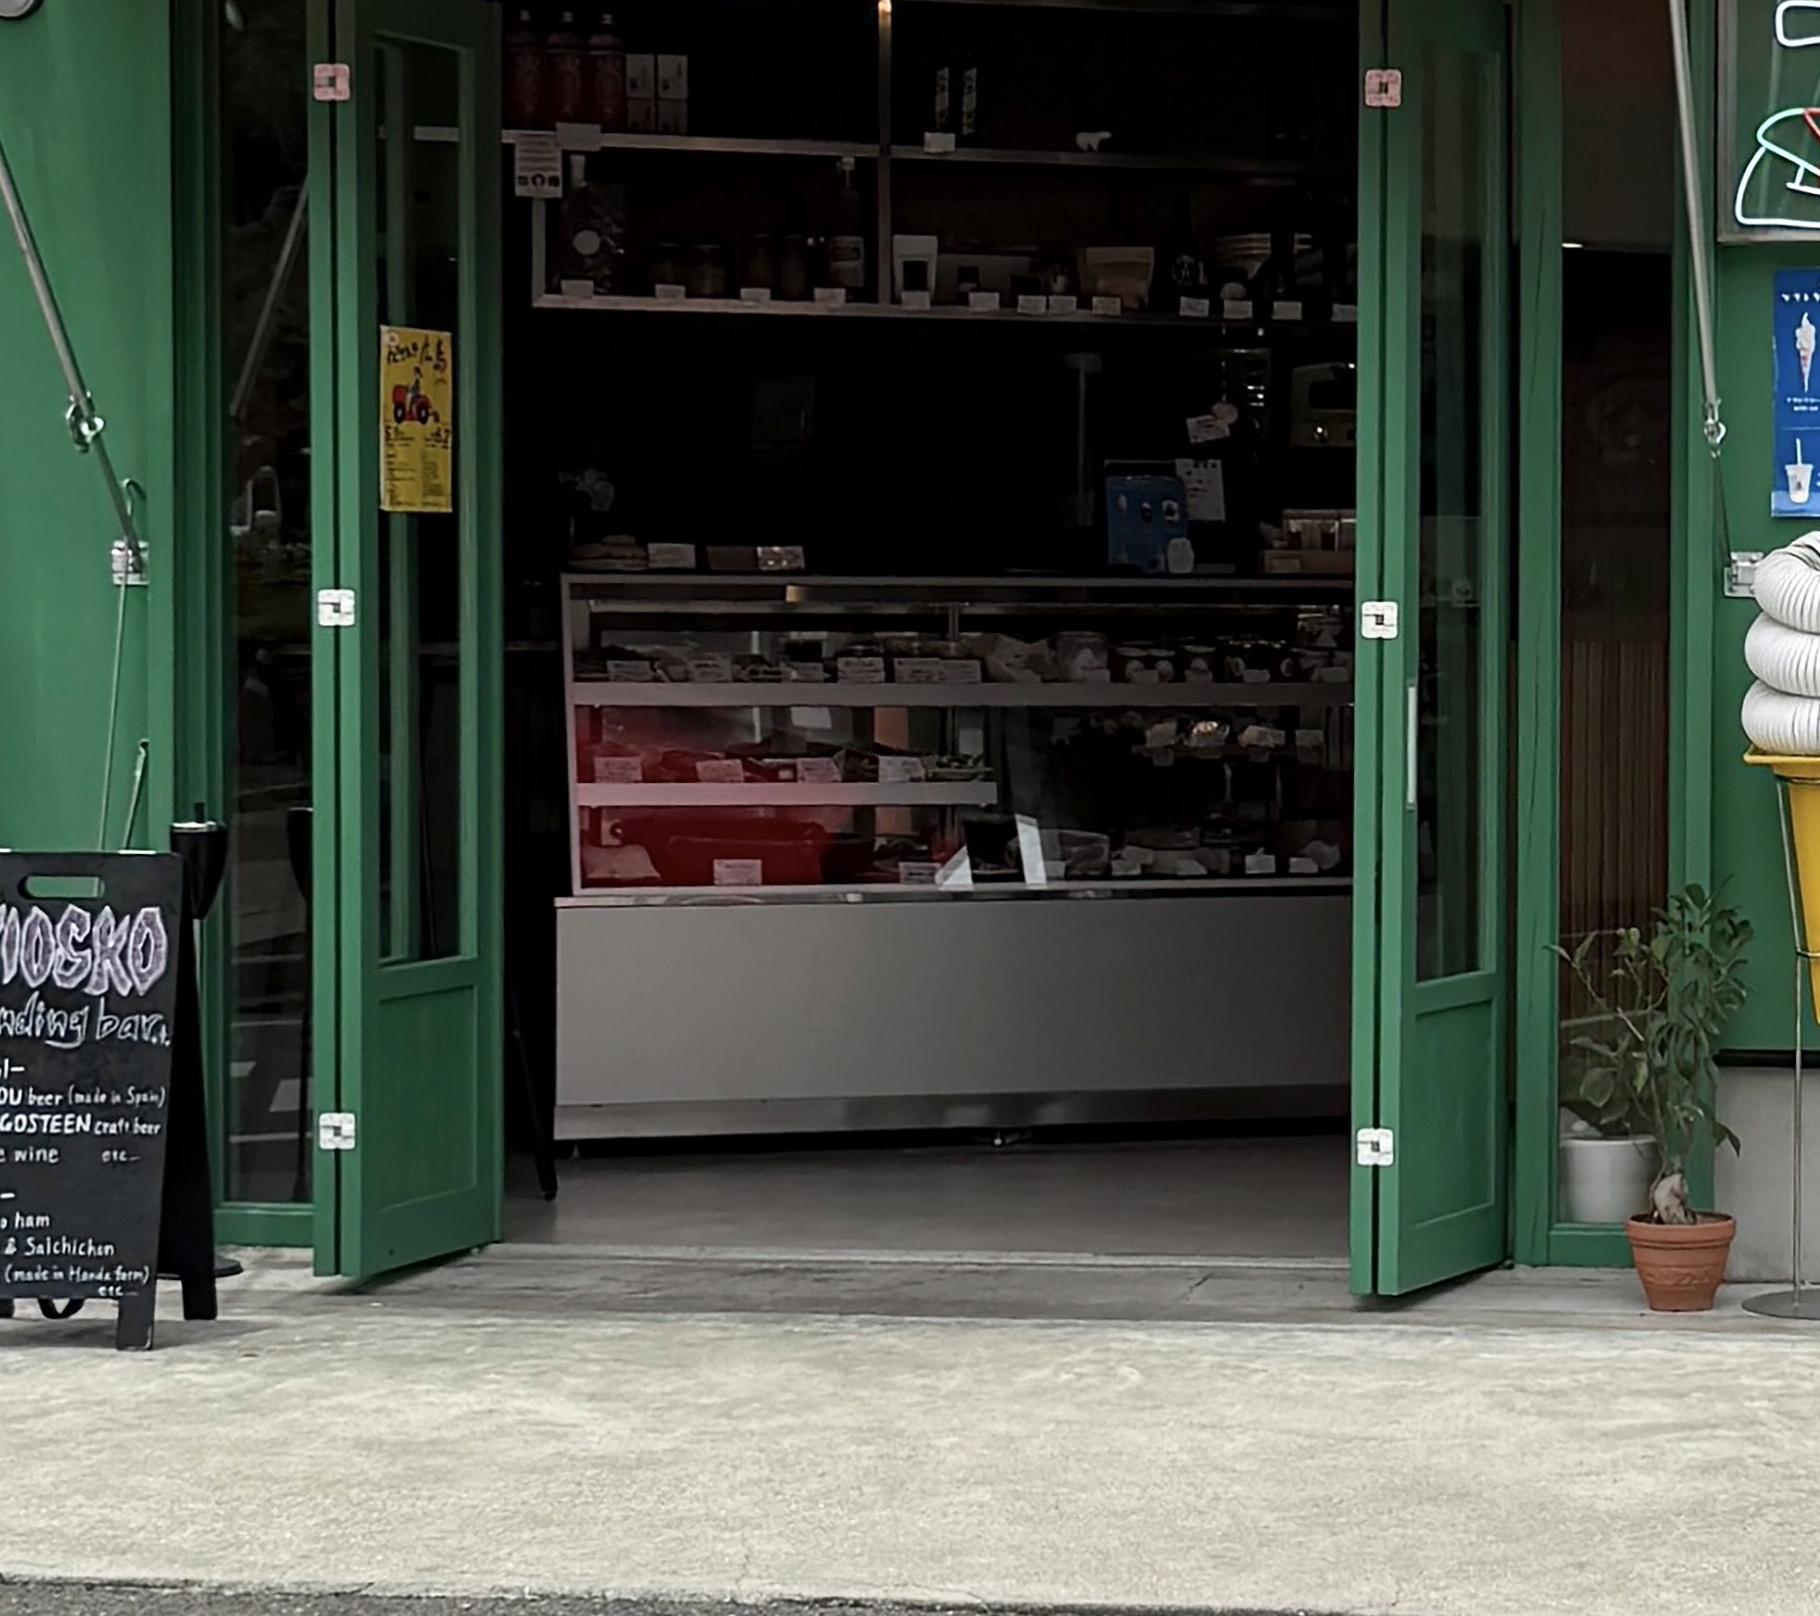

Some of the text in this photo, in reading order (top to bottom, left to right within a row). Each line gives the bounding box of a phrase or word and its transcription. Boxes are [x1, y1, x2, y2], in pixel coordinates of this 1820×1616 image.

[0, 903, 168, 997] IOSKO
[28, 1087, 63, 1105] beer
[94, 1118, 130, 1135] craft
[133, 1116, 162, 1135] beer
[14, 1145, 60, 1164] wine
[14, 1210, 50, 1230] ham
